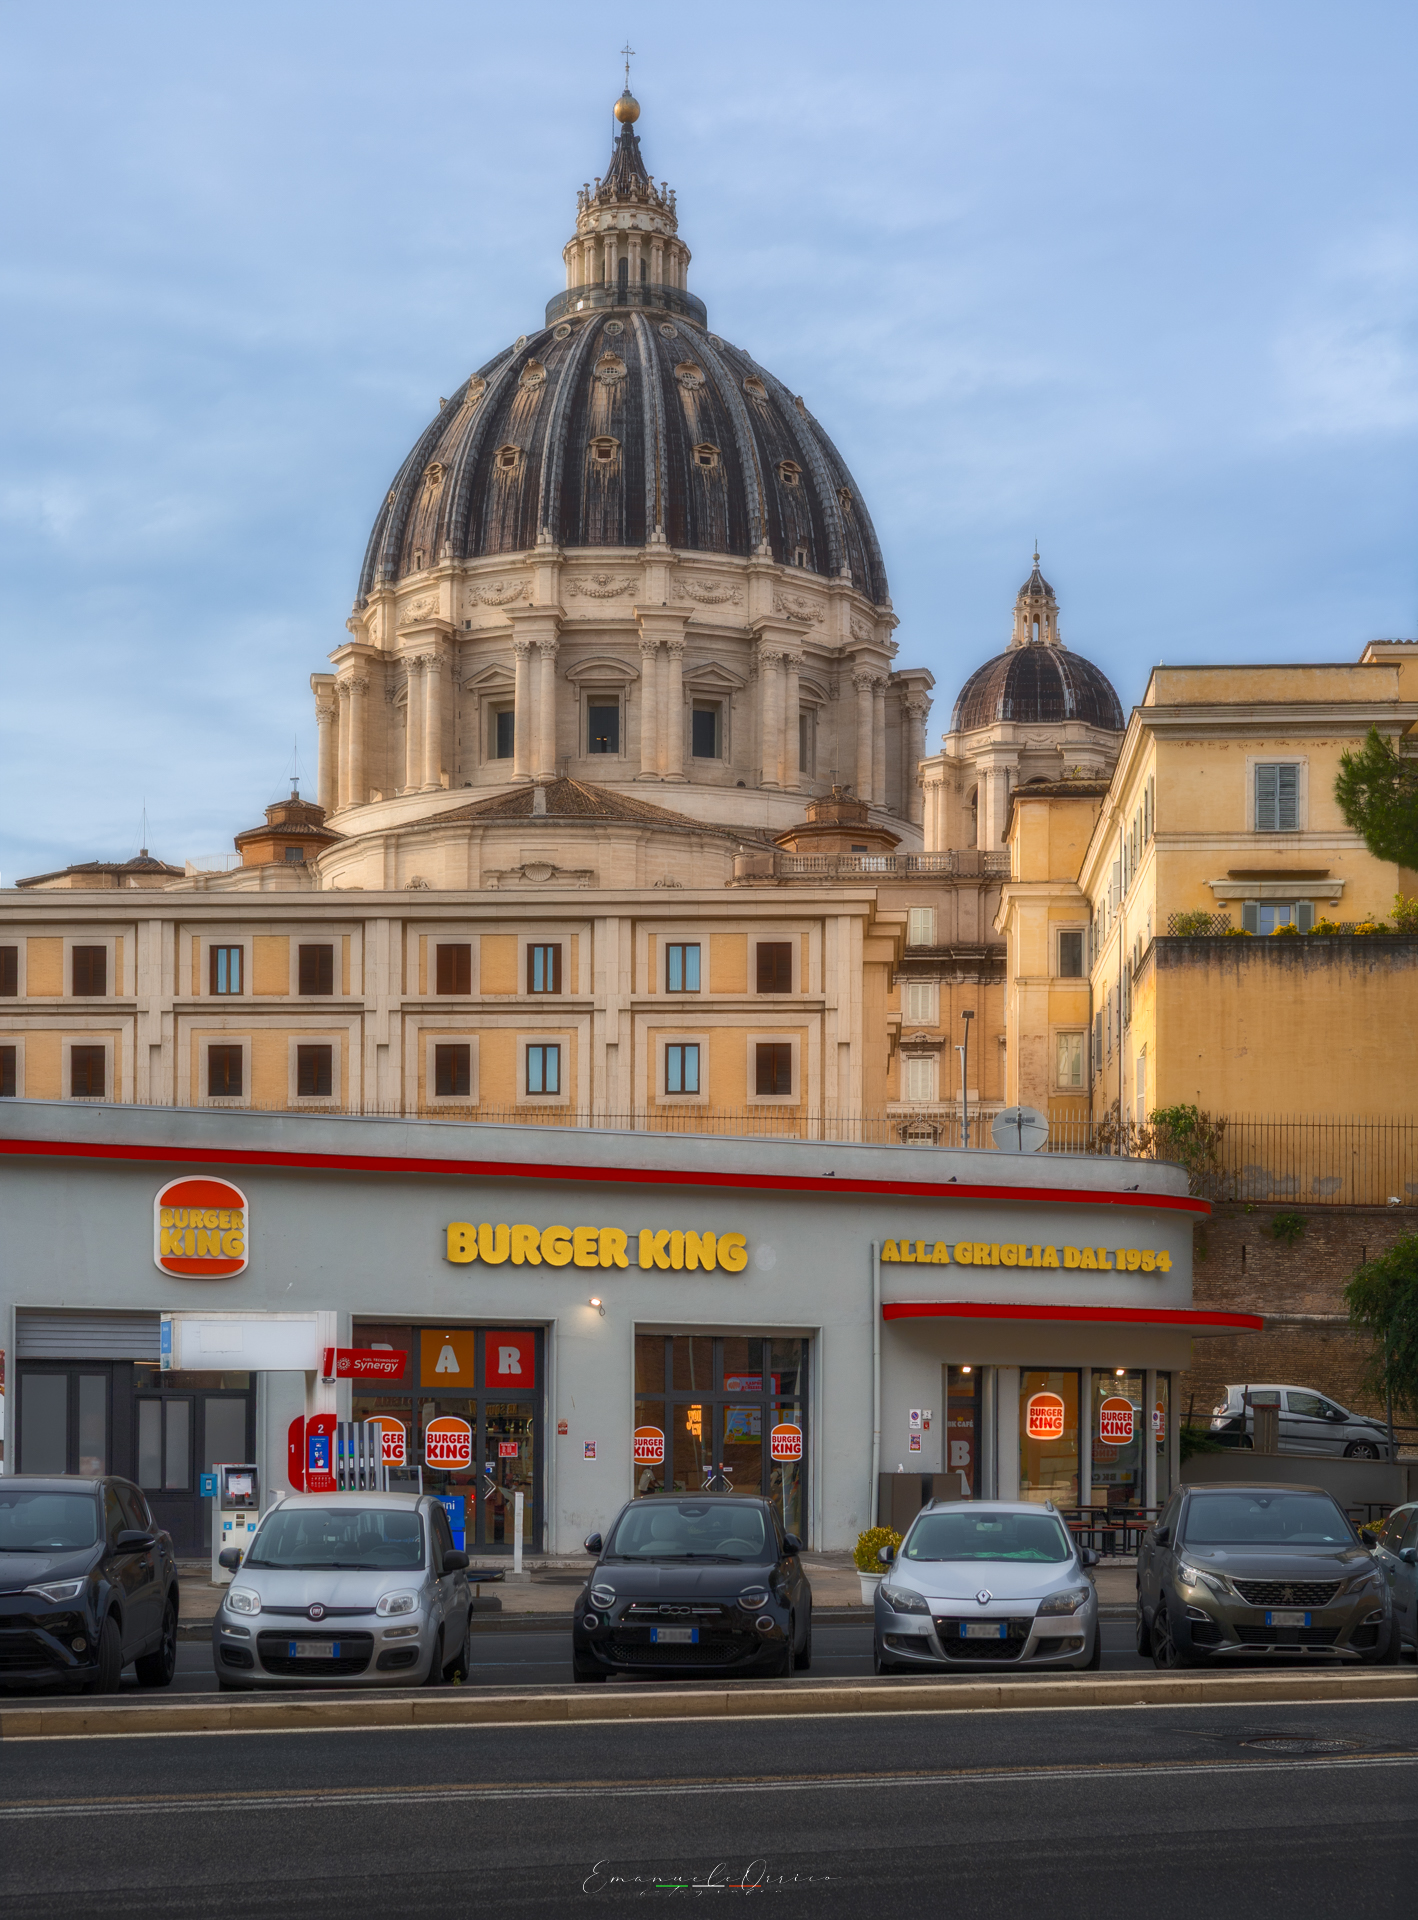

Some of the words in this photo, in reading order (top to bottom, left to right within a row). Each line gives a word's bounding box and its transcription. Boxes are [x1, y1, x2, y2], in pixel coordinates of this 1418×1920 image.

[160, 1208, 245, 1230] BURGER
[160, 1228, 245, 1257] KING
[447, 1222, 629, 1268] BURGER
[638, 1229, 748, 1272] KING
[881, 1239, 950, 1264] ALLA
[953, 1242, 1060, 1268] GRIGLIA
[1063, 1246, 1112, 1270] DAL
[1115, 1248, 1173, 1272] 1954
[354, 1359, 398, 1373] Synergy
[1029, 1408, 1063, 1417] BURGER
[1101, 1411, 1133, 1422] BURGER
[317, 1424, 324, 1434] 2
[957, 1419, 974, 1428] CAFÉ
[1029, 1417, 1063, 1430] KING
[1101, 1422, 1133, 1435] KING
[382, 1433, 405, 1444] GER
[427, 1434, 470, 1444] BURGER
[634, 1438, 663, 1446] BURGER
[772, 1435, 801, 1443] BURGER
[290, 1444, 295, 1453] 1
[382, 1444, 405, 1459] NG
[427, 1444, 470, 1459] KING
[634, 1446, 663, 1457] KING
[772, 1443, 801, 1454] KING
[658, 1604, 691, 1615] 500
